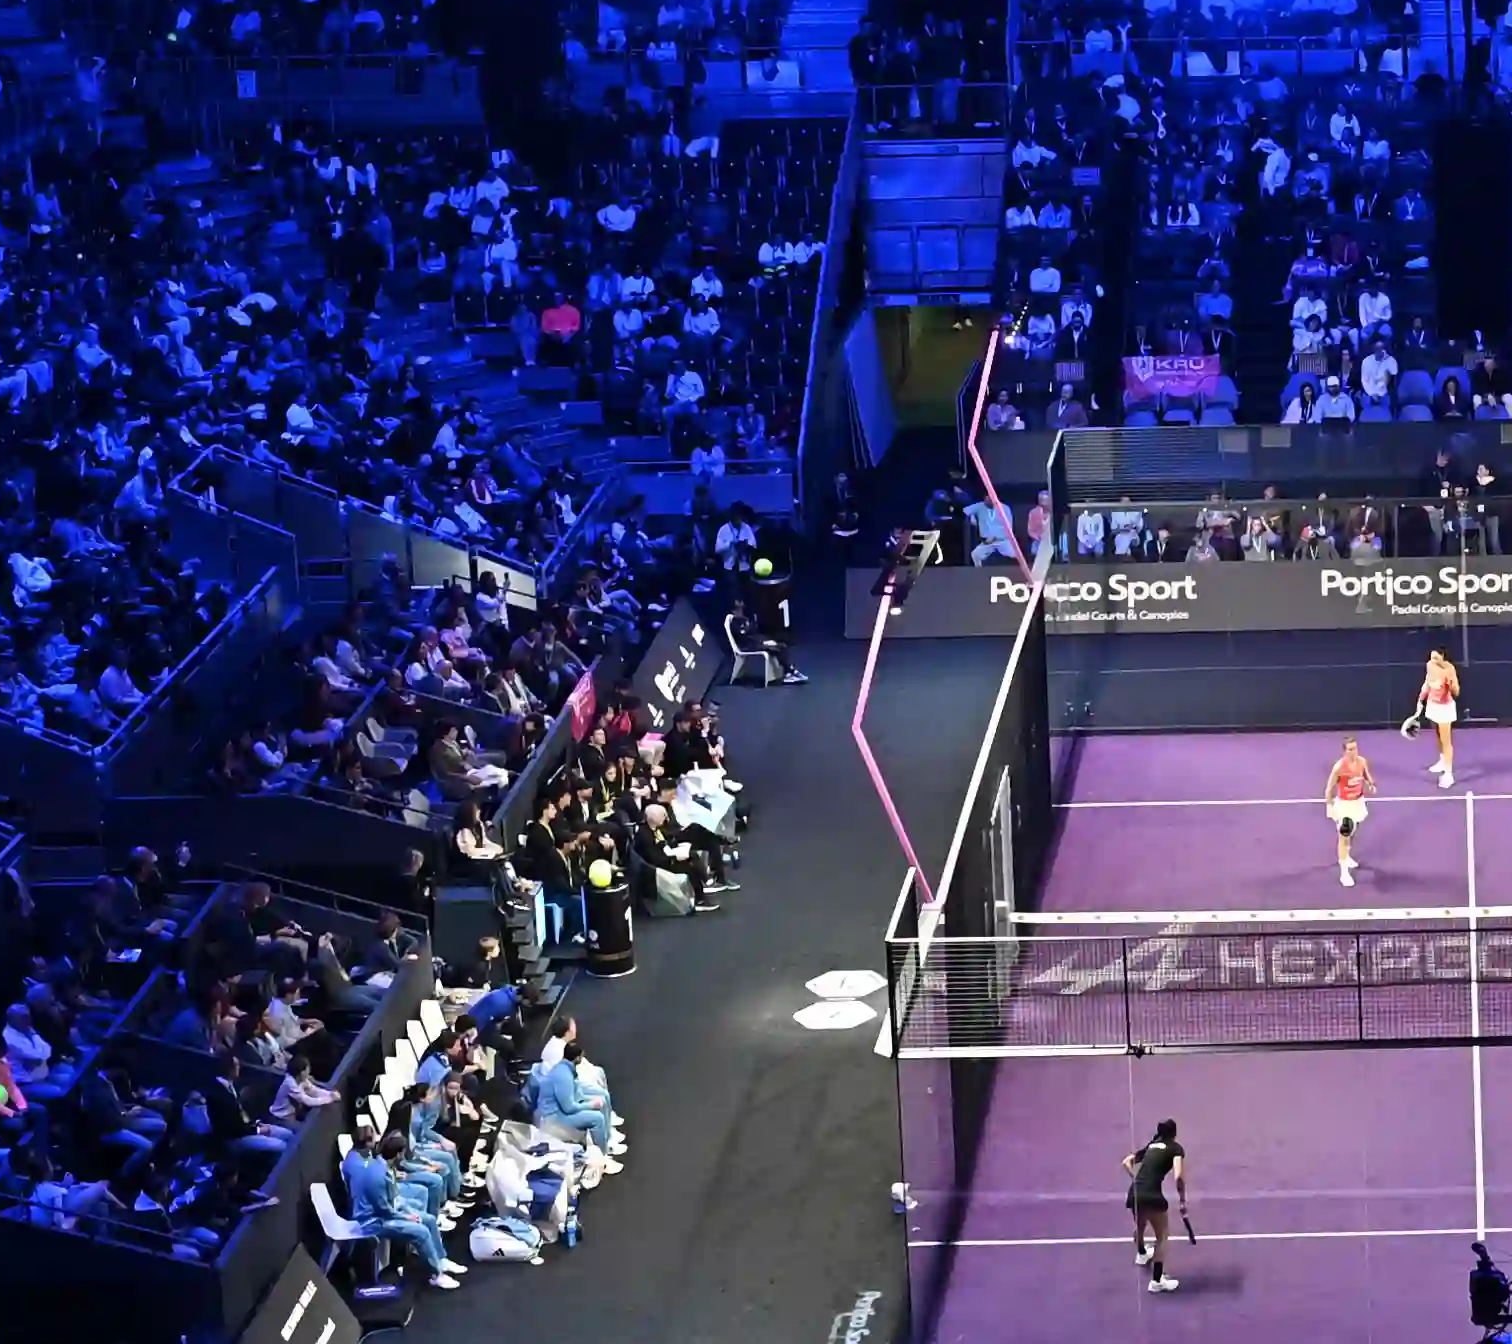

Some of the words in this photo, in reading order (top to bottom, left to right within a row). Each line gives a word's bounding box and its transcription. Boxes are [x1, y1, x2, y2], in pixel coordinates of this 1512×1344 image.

[1108, 573, 1198, 607] Sport
[1321, 568, 1433, 605] Portico
[778, 599, 790, 628] 1
[1391, 604, 1421, 615] Padel
[1422, 604, 1457, 615] Courts
